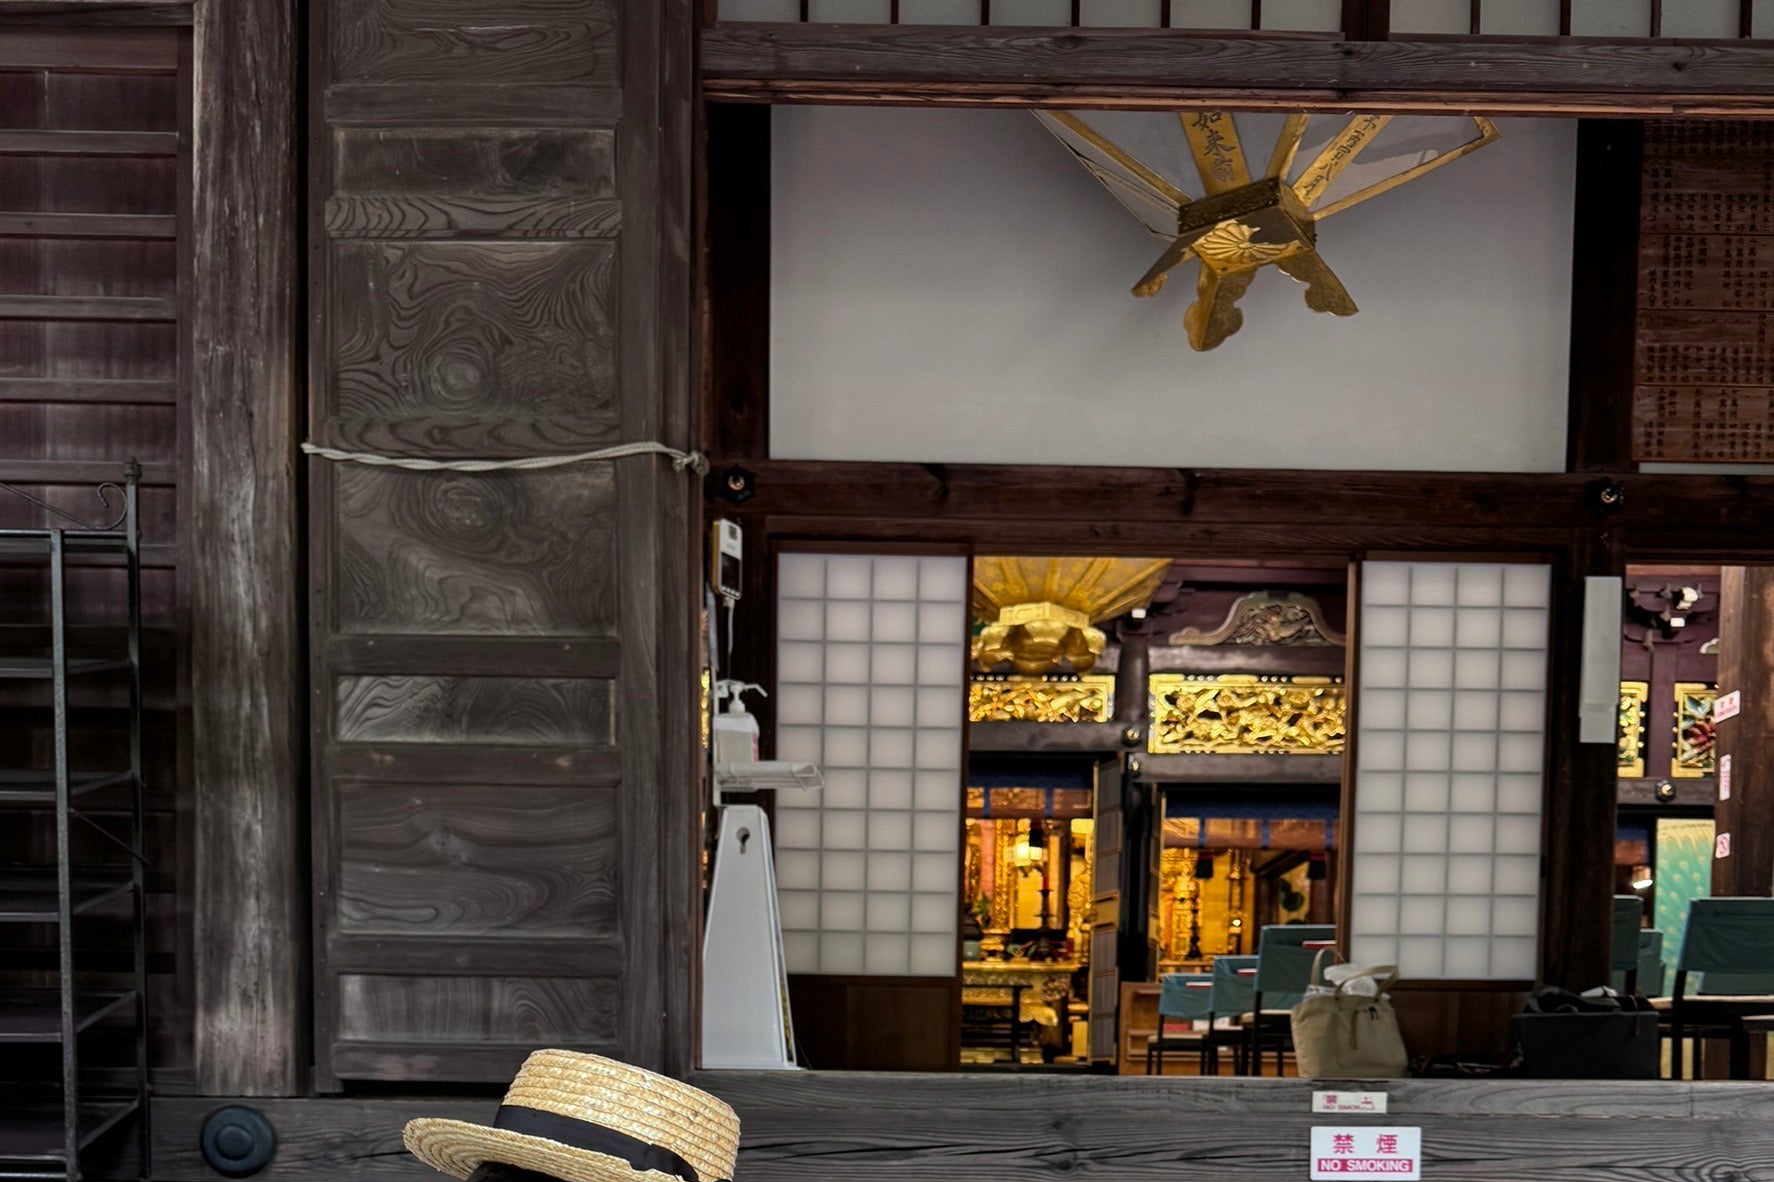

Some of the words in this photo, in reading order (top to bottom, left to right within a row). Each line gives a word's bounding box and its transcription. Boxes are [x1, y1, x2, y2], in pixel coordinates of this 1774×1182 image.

[1333, 1134, 1397, 1154] 禁煙
[1321, 1160, 1341, 1171] NO
[1347, 1160, 1410, 1172] SMOKING
